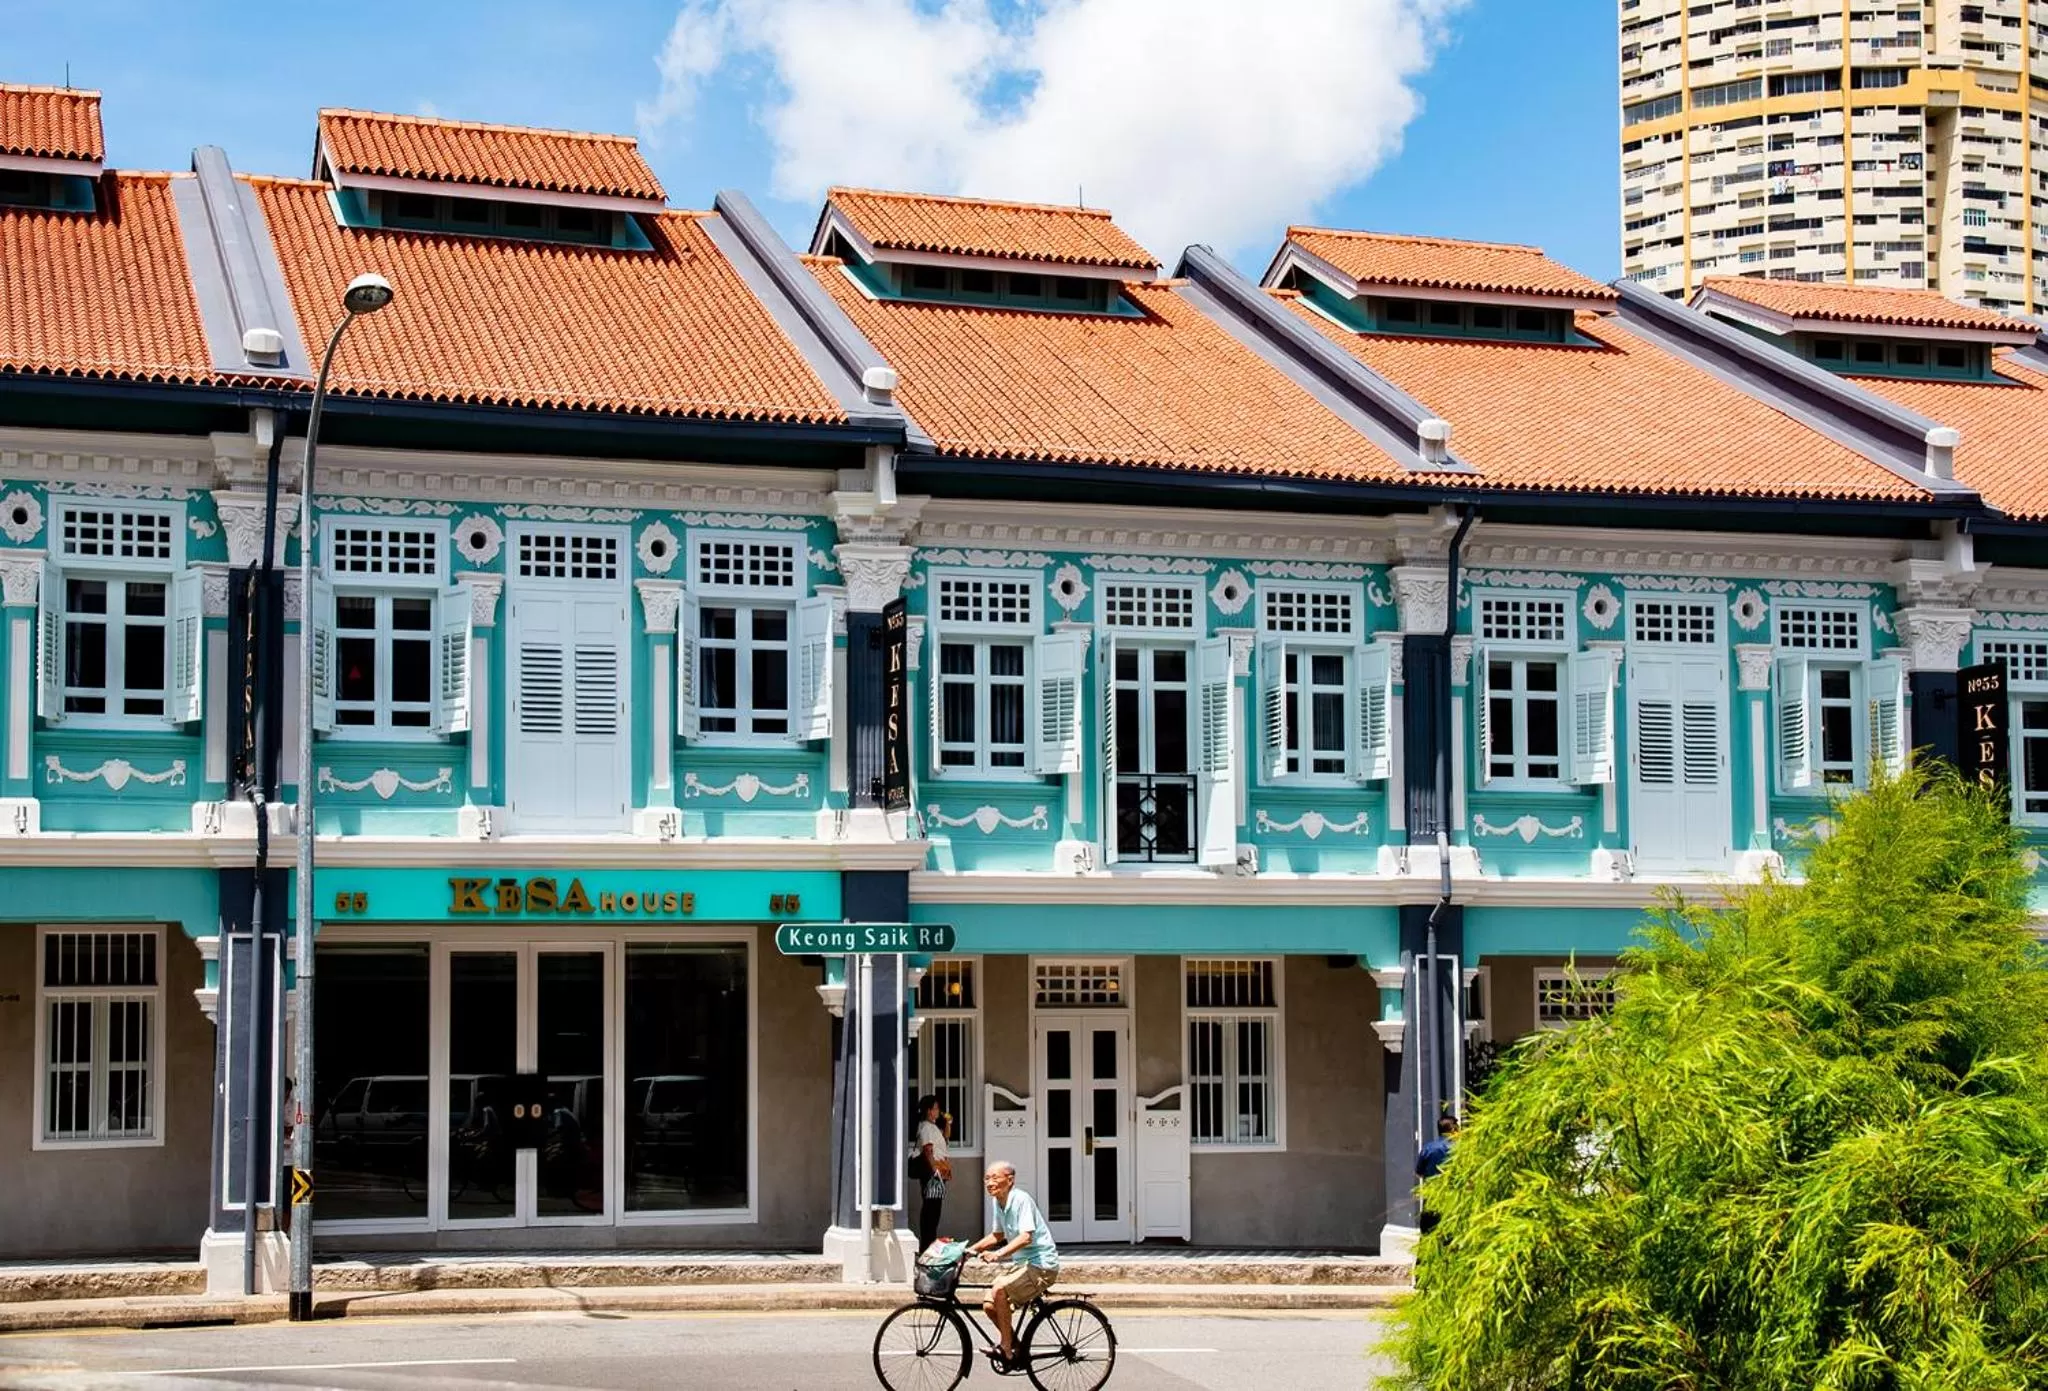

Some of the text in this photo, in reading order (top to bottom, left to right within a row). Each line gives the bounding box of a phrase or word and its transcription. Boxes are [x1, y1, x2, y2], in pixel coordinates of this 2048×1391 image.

[335, 892, 369, 913] 55
[600, 892, 695, 913] HOUSE
[769, 893, 801, 914] 55
[789, 927, 944, 951] Keong Saik Rd
